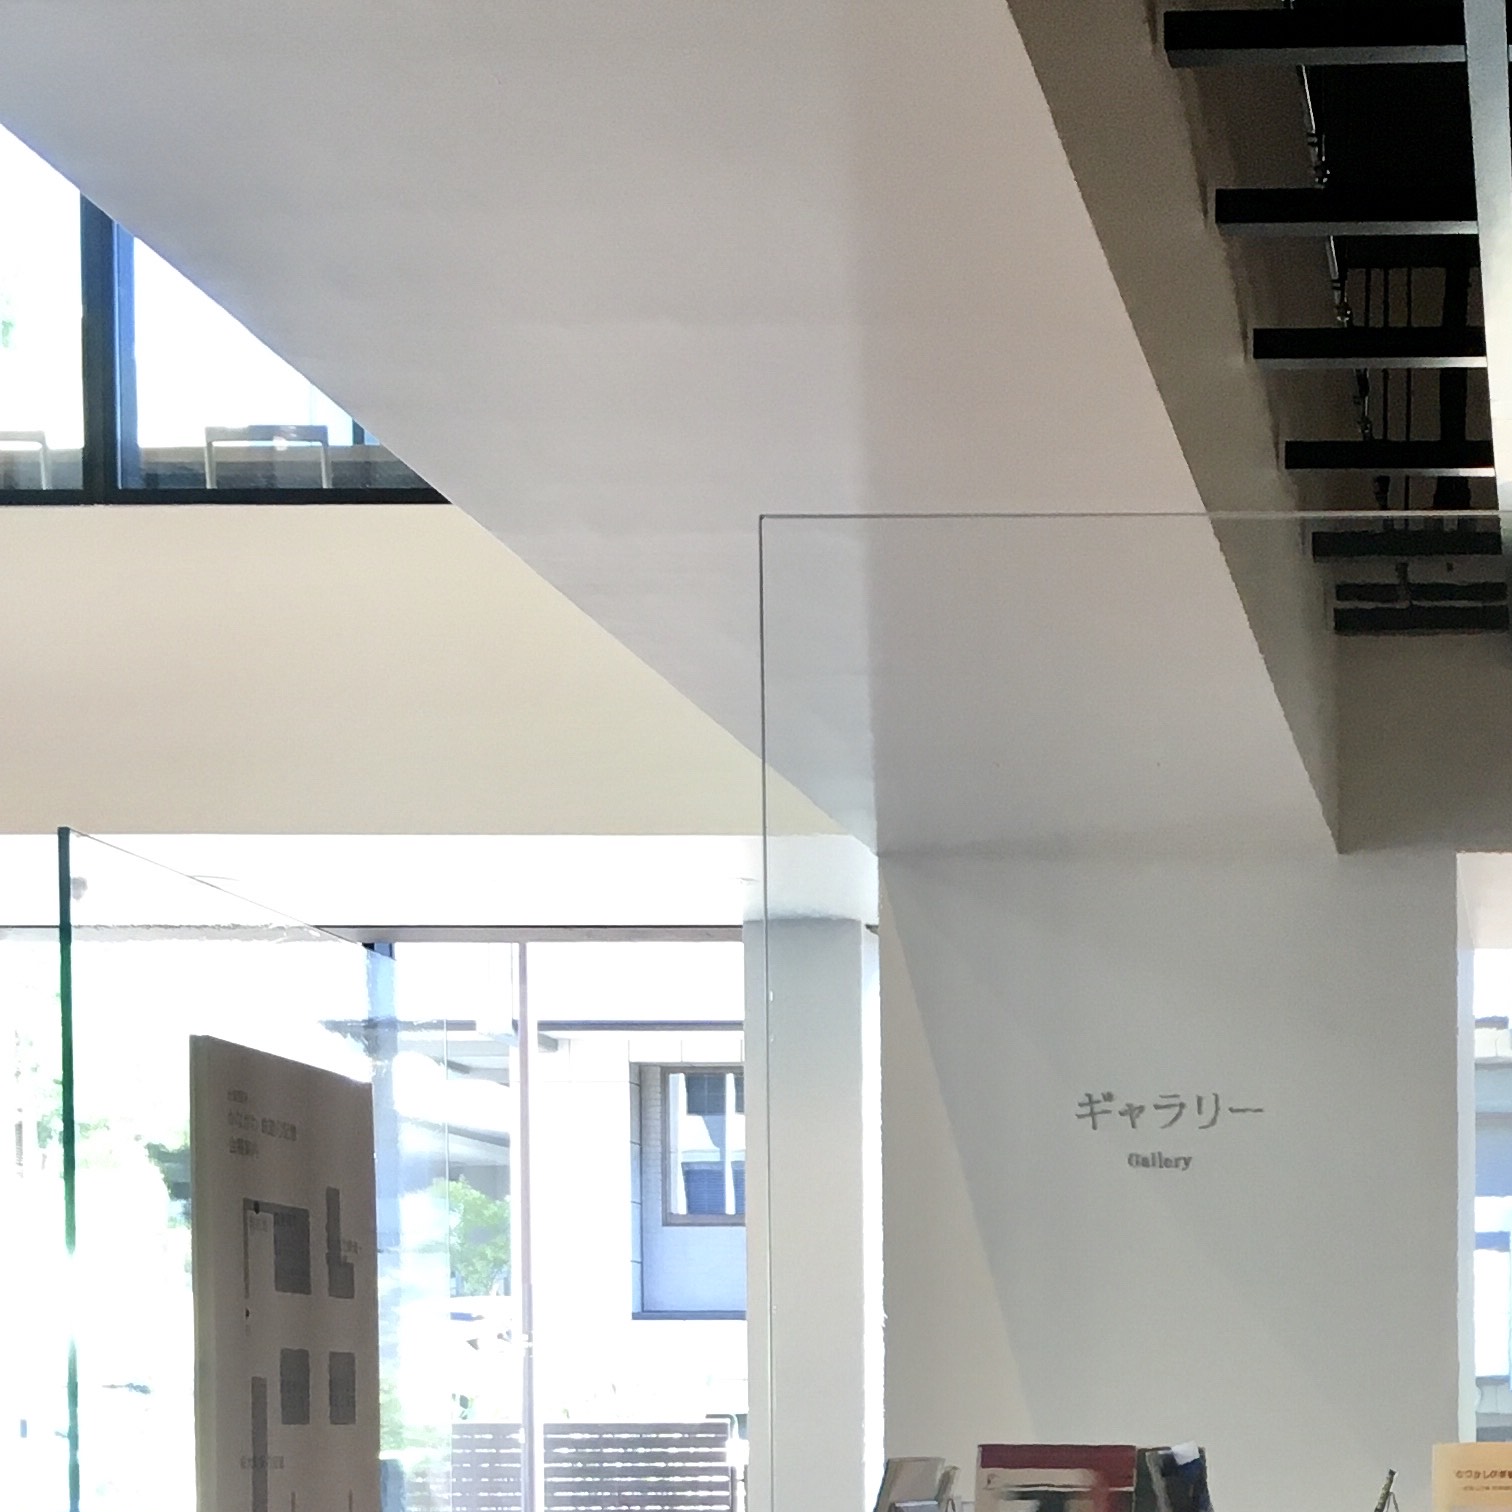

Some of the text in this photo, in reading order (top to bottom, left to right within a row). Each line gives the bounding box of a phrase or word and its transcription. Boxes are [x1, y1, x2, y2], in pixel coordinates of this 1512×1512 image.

[1075, 1091, 1265, 1131] ギャラリー
[1127, 1151, 1193, 1172] Gallery
